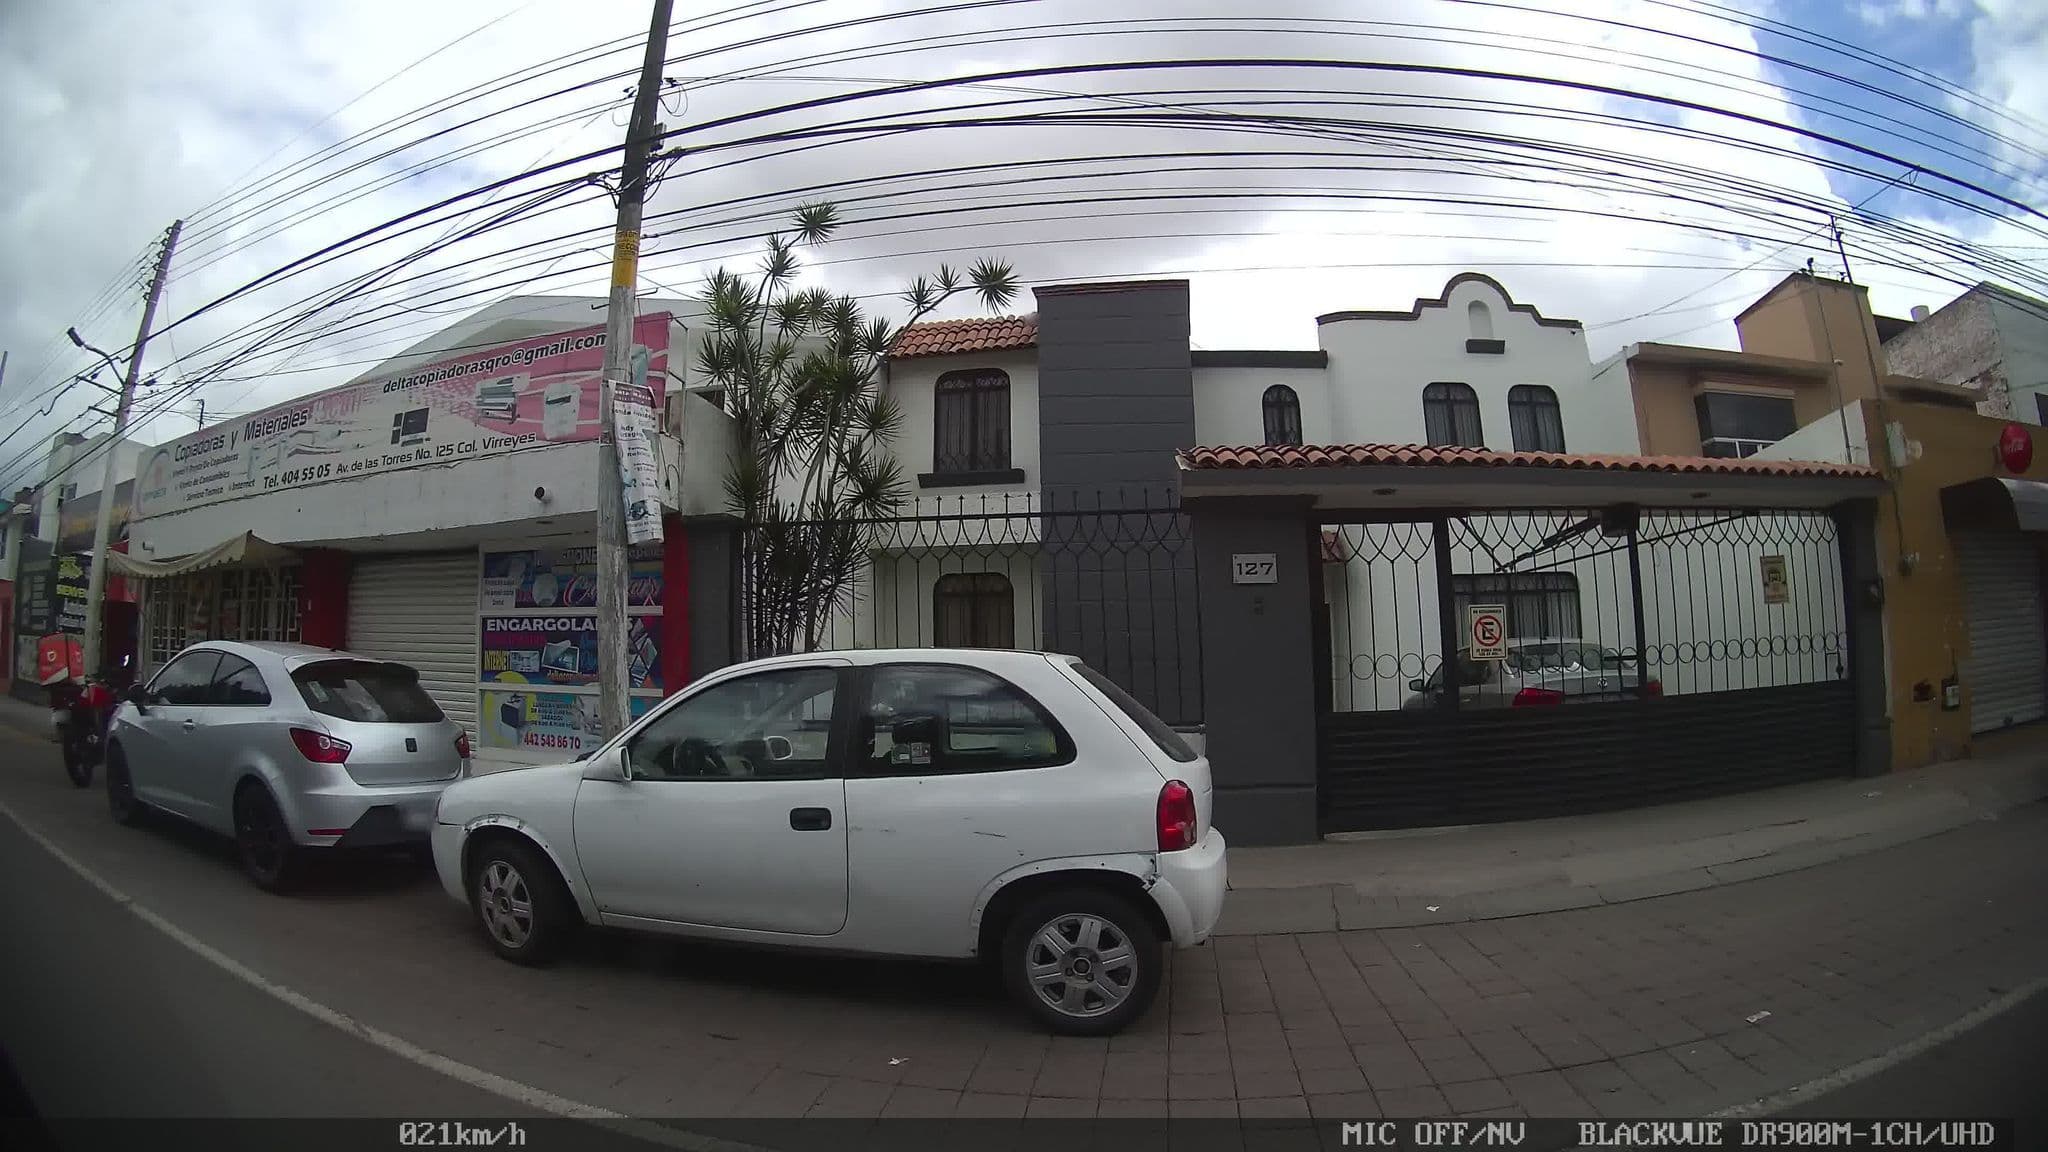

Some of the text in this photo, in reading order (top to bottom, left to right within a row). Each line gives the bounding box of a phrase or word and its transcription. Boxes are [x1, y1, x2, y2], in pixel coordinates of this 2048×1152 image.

[383, 333, 607, 393] deltacopiadorasqro@gmail.com
[175, 434, 225, 464] Copiadoras
[243, 409, 308, 442] Materiales
[263, 432, 535, 489] Tel. 404 55 05 Av. de las Torres No. 125 Col. Virreyes
[1236, 562, 1274, 576] 127
[524, 731, 581, 749] 442 543 86 70
